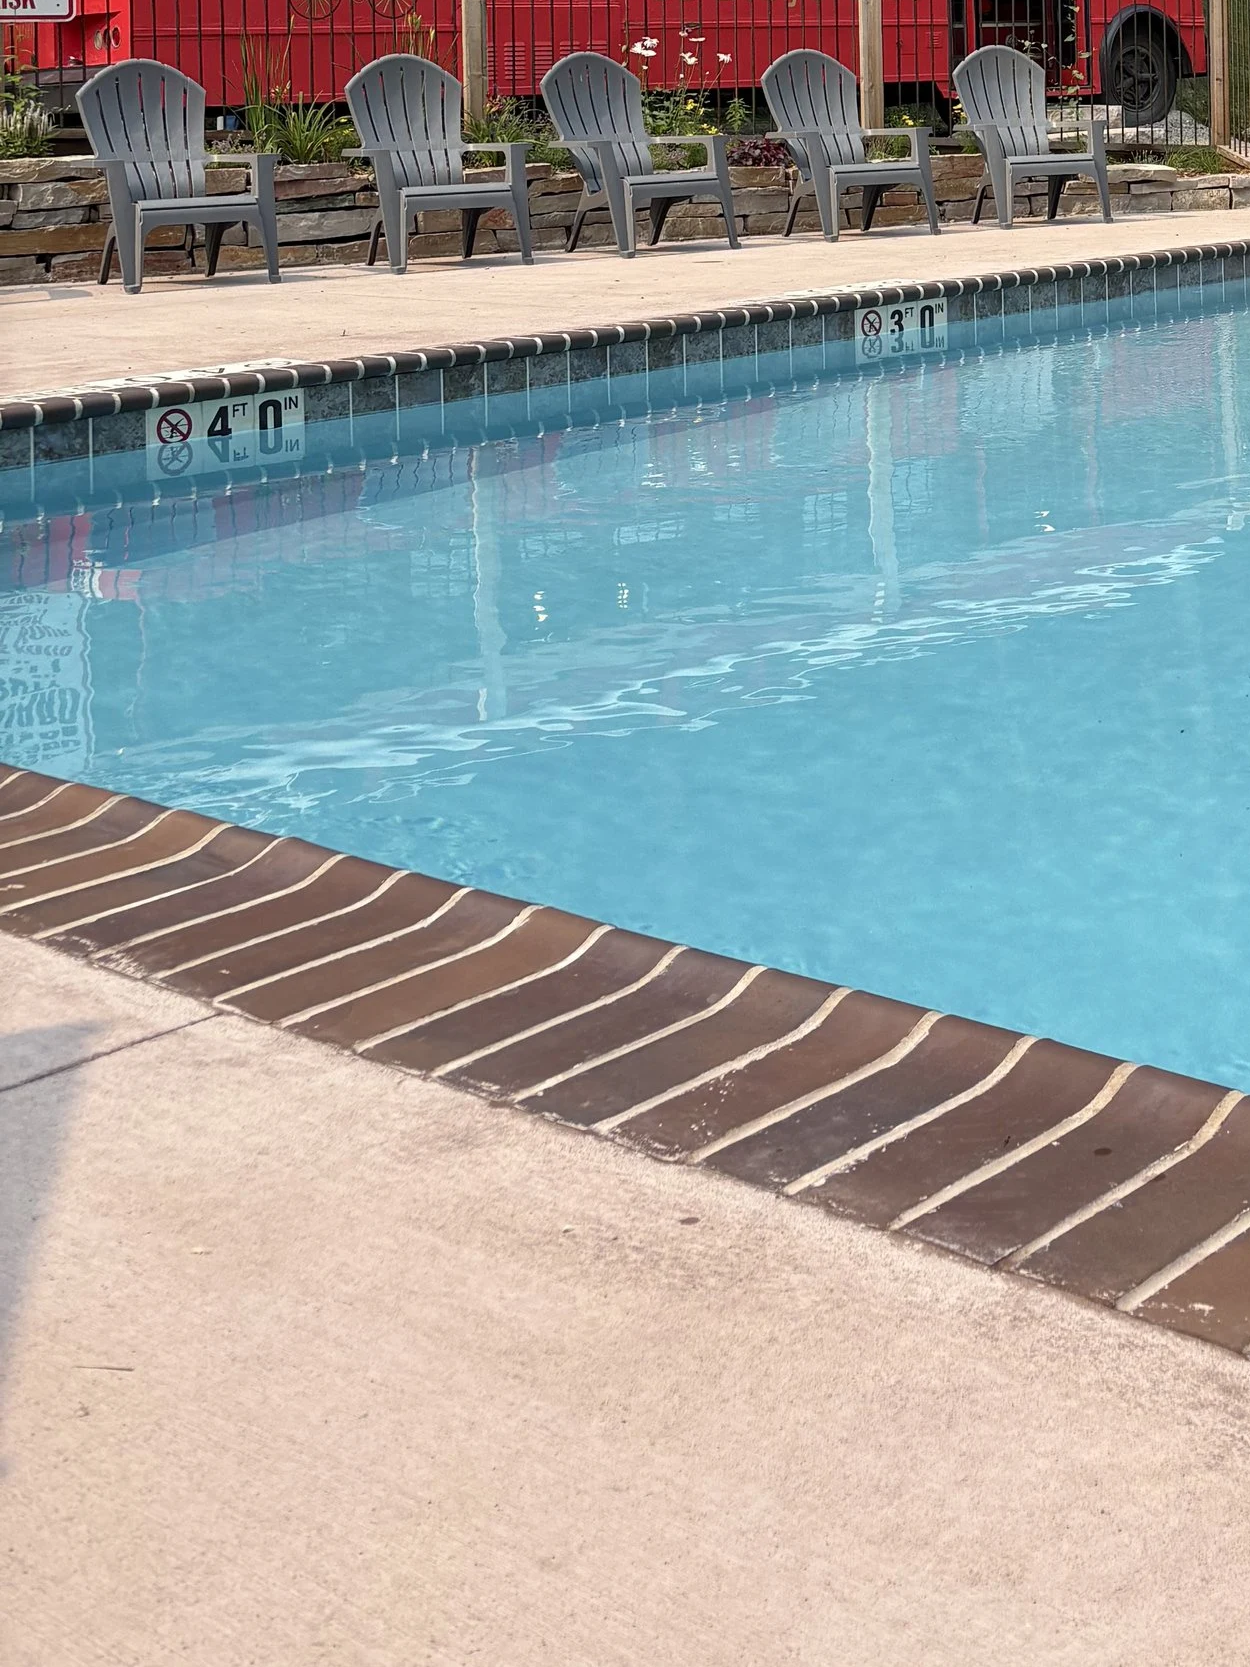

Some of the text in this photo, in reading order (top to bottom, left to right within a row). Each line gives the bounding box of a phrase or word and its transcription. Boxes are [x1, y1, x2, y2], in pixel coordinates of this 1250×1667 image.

[890, 302, 944, 334] 3 FT 0 IN
[207, 395, 299, 437] 4 FT 0 IN
